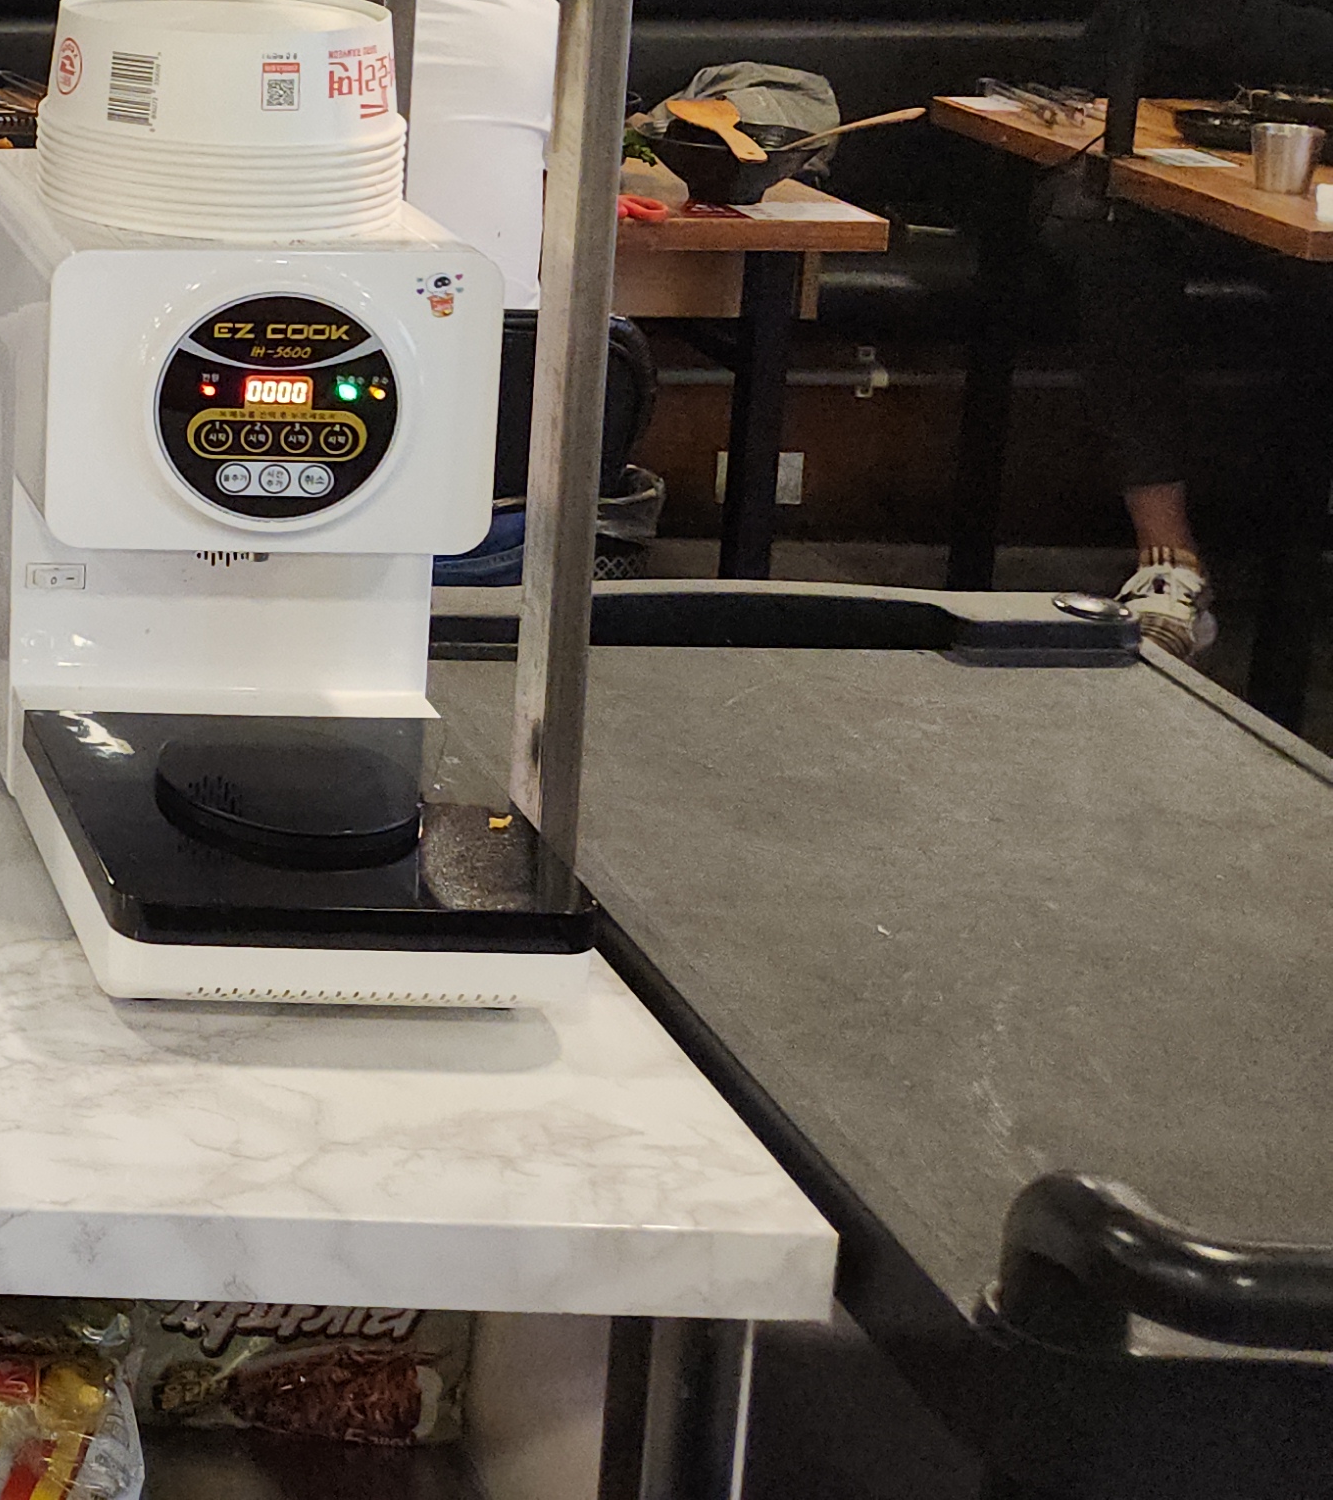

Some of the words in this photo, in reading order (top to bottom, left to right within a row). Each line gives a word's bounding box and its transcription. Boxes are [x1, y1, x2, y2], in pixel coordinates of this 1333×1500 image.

[214, 322, 255, 338] EZ
[266, 324, 350, 340] COOK
[251, 345, 312, 359] IH-5600
[245, 381, 307, 404] 0000
